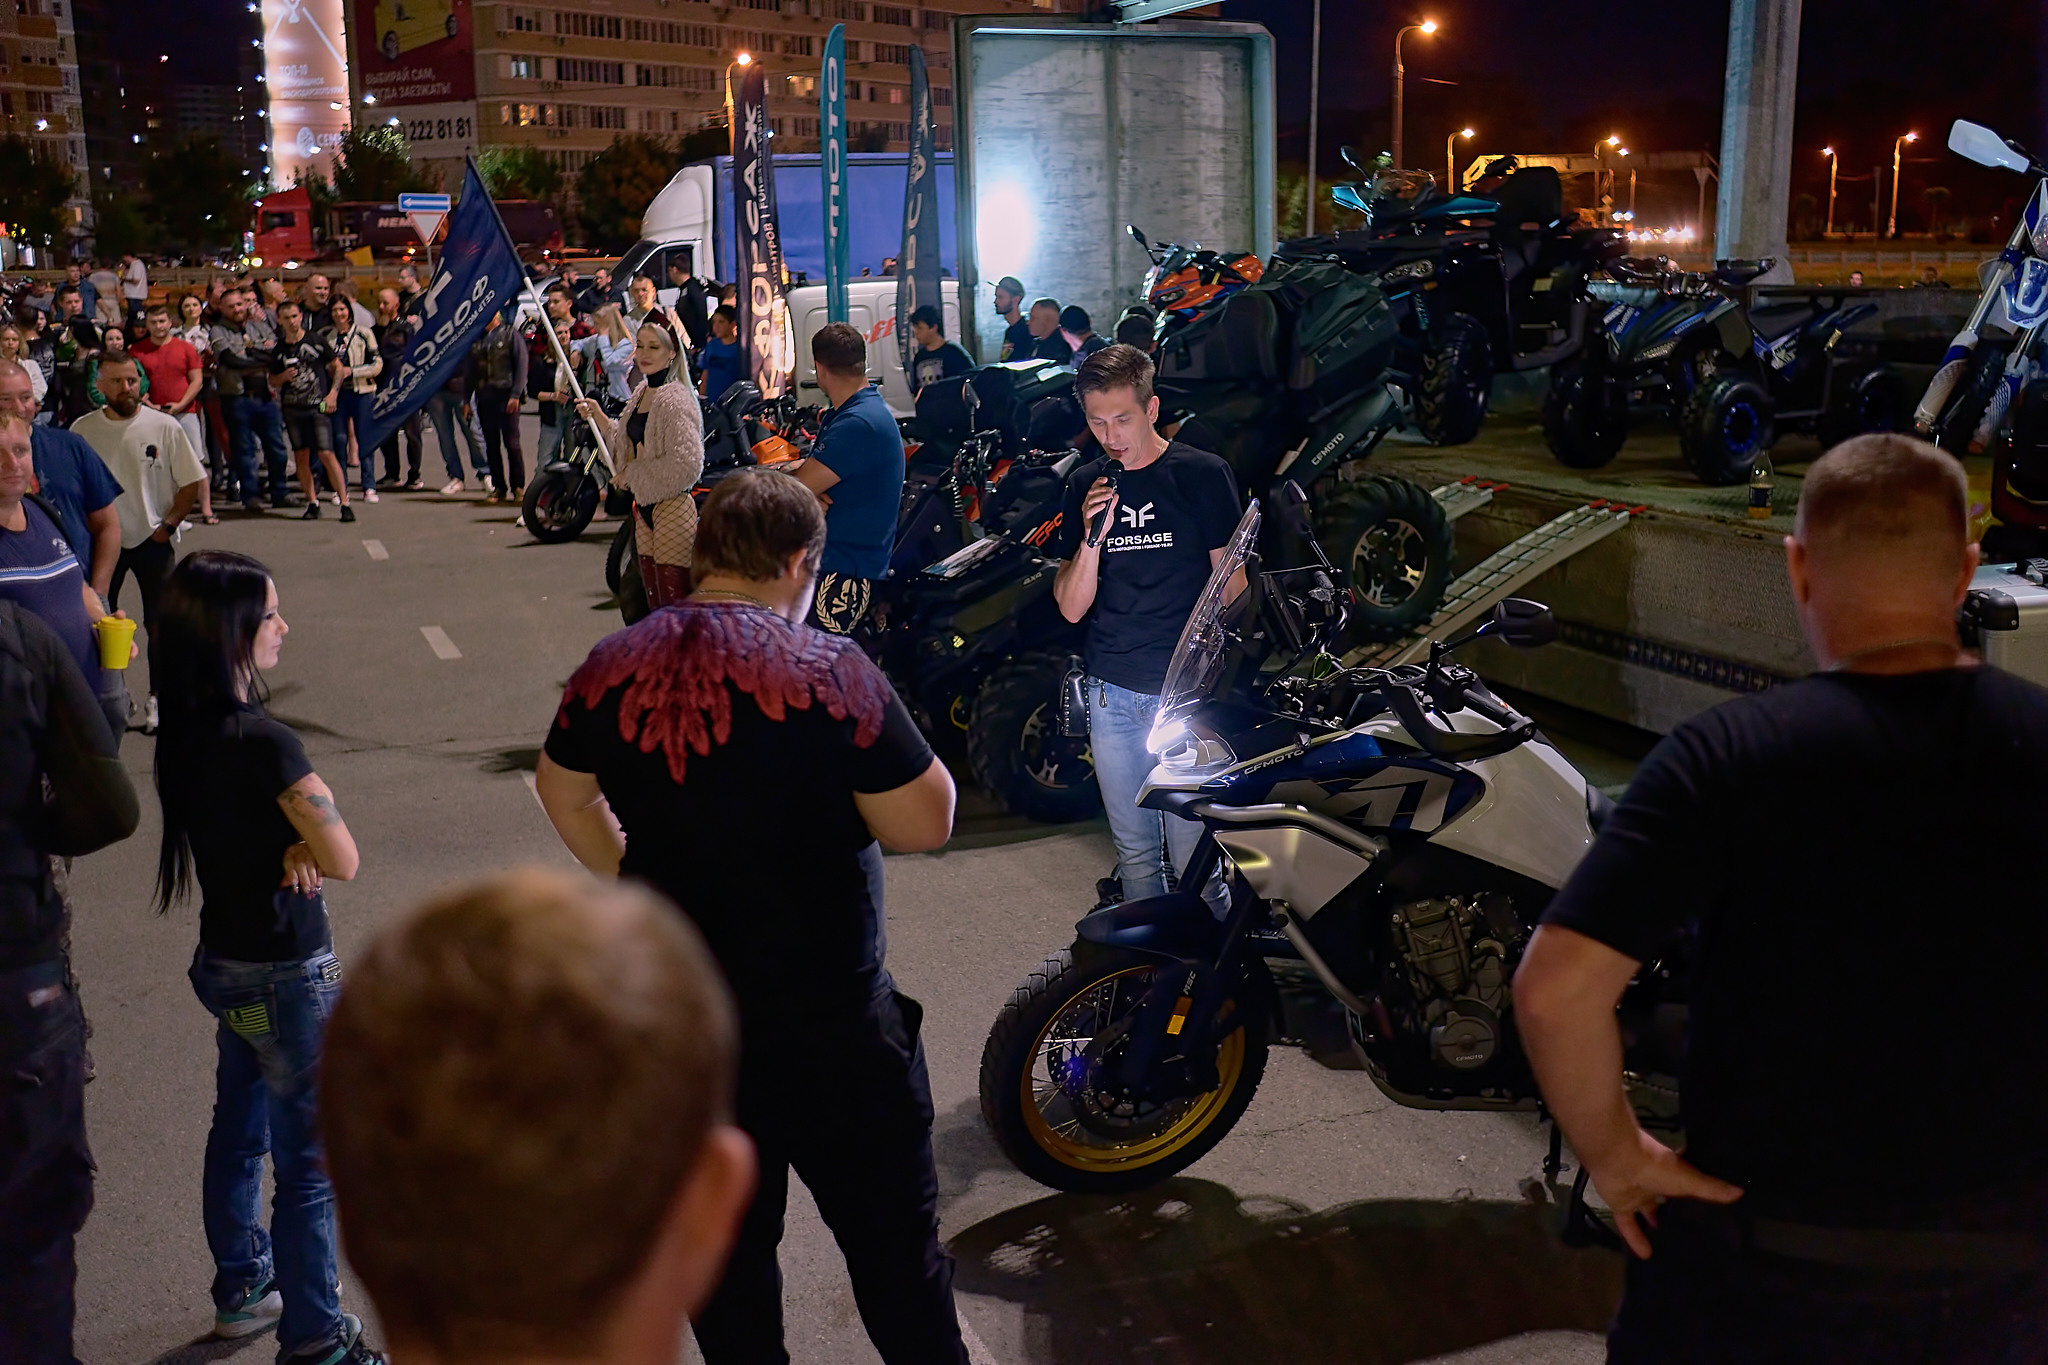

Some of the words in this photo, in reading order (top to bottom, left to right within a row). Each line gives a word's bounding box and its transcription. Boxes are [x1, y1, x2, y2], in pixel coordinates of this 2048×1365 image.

[409, 120, 434, 140] 222
[437, 118, 452, 138] 81
[456, 116, 471, 138] 81
[1311, 432, 1345, 466] CFMOTO
[1107, 532, 1173, 547] FORSAGE
[1243, 750, 1305, 775] CFMOTO
